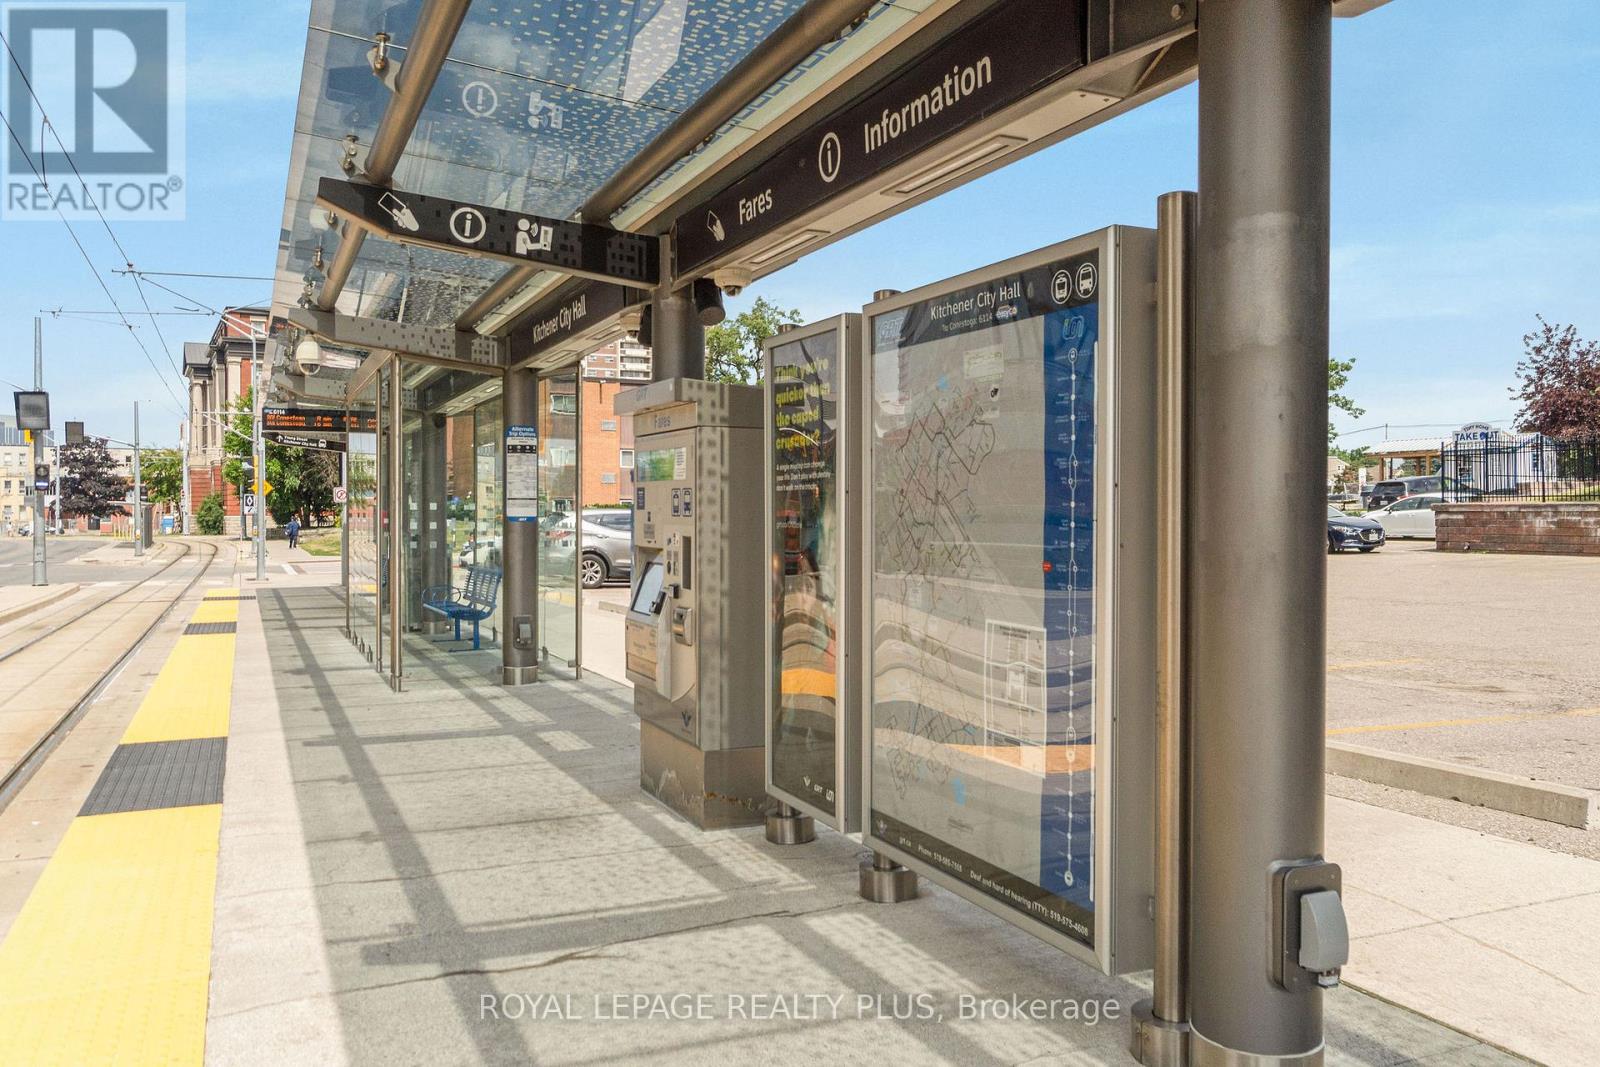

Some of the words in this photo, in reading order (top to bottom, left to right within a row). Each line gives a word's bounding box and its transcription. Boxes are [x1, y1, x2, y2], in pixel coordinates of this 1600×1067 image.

[864, 55, 992, 153] Information
[738, 188, 773, 225] Fares
[532, 316, 558, 344] Kitchener
[559, 307, 572, 330] City
[572, 293, 587, 321] Hall
[930, 297, 975, 321] Kitchener
[977, 291, 997, 309] City
[999, 281, 1021, 302] Hall
[776, 411, 791, 428] the
[791, 406, 819, 427] caped
[1455, 432, 1479, 441] TAKE
[1011, 890, 1031, 909] hearing
